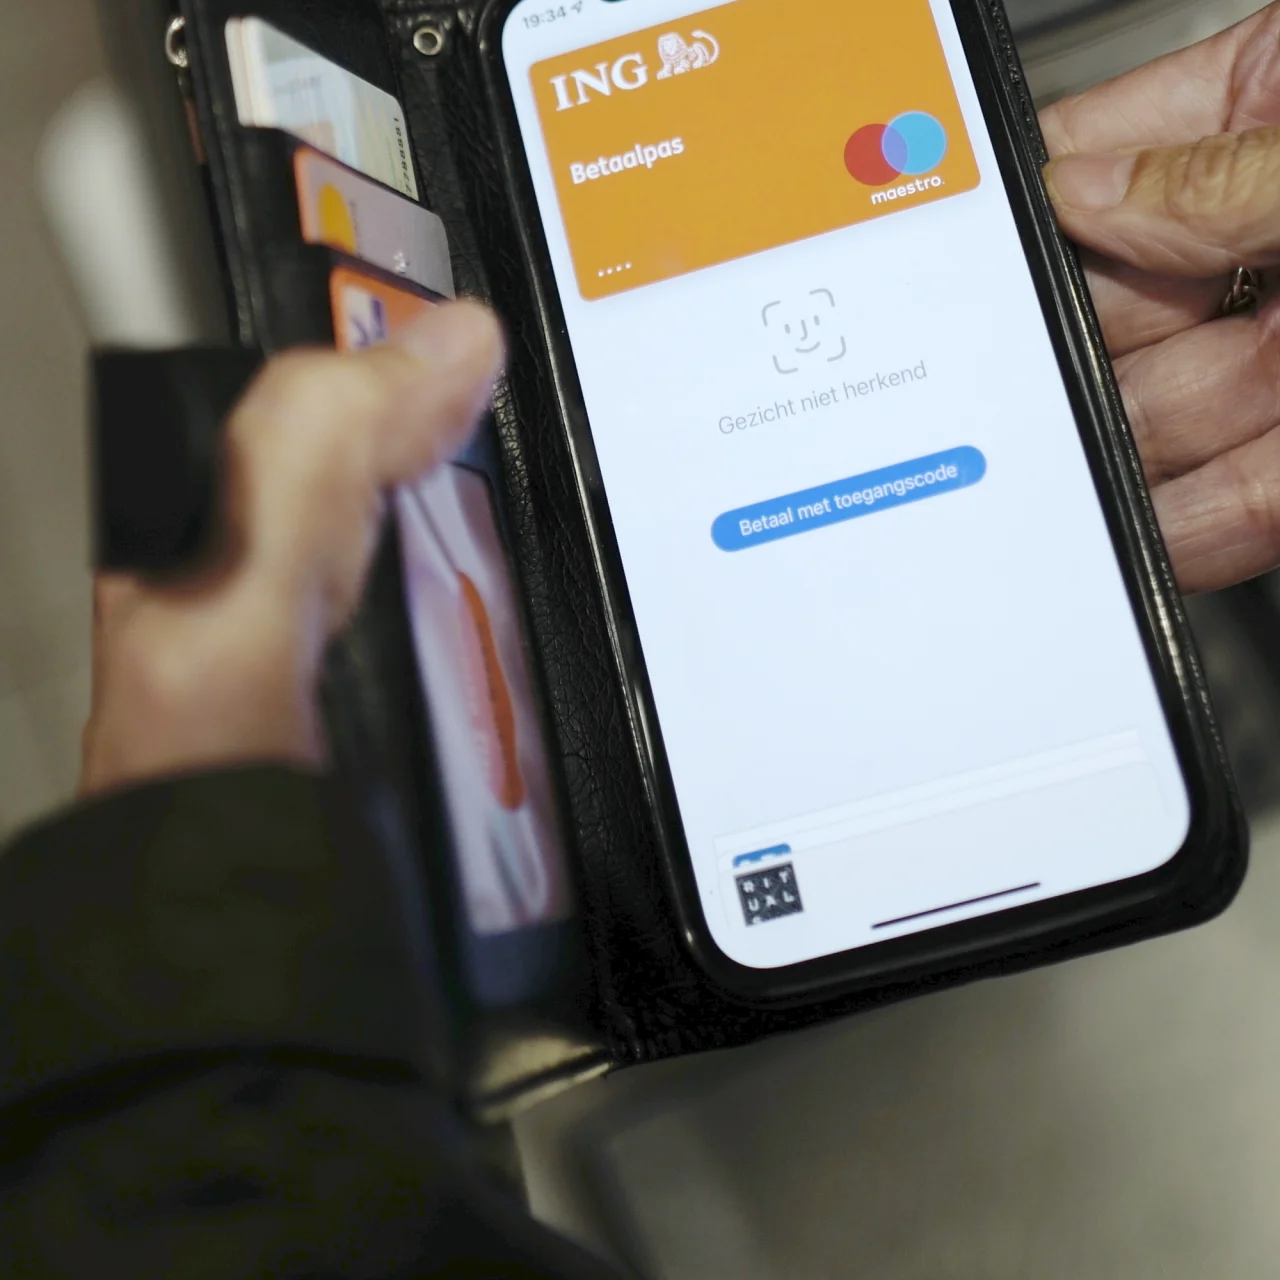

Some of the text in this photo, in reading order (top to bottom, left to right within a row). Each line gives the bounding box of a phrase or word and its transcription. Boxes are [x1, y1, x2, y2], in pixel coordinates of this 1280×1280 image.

[523, 5, 567, 29] 19:34
[549, 53, 649, 111] ING
[570, 136, 685, 185] Betaalpas
[718, 360, 928, 435] Gezicht niet herkend
[739, 462, 958, 537] Betaal met toegangscode
